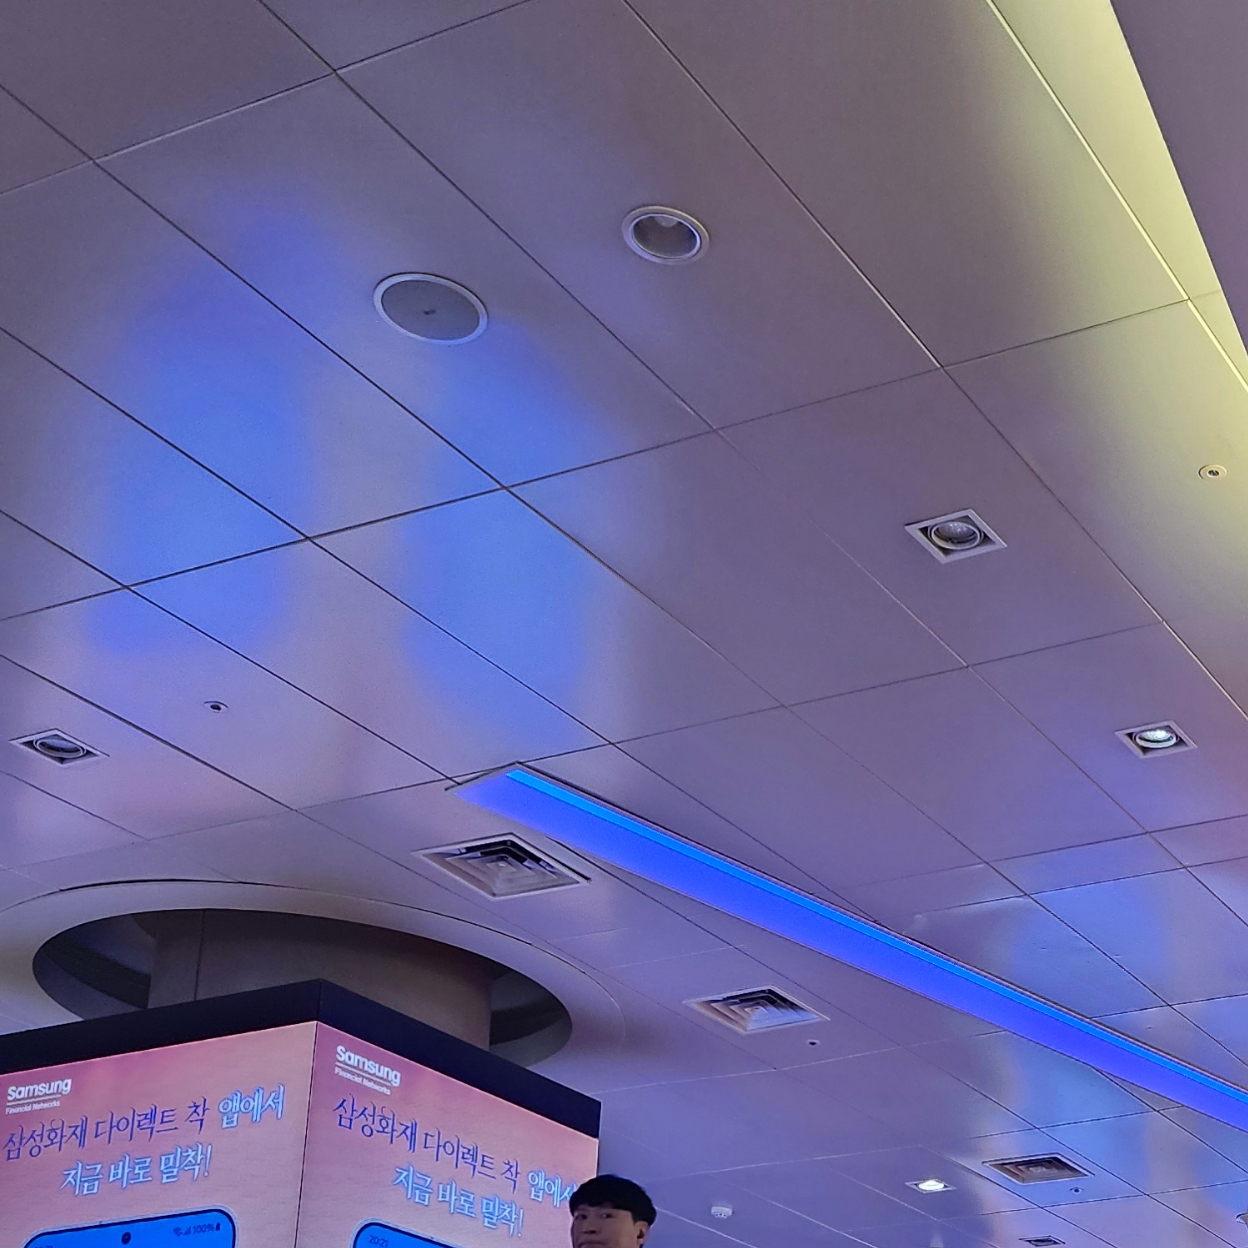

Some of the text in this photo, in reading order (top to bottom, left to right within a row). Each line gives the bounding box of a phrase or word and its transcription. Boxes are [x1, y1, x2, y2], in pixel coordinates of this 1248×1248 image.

[7, 1079, 72, 1100] Samsung
[336, 1046, 401, 1087] Samsung
[4, 1083, 286, 1161] 삼성화재 다이렉트 착 앱에서
[333, 1093, 418, 1153] 삼성화재
[423, 1128, 497, 1180] 다이렉트
[501, 1158, 521, 1194] 착
[60, 1143, 213, 1196] 지금 바로 밀착!
[393, 1163, 524, 1238] 지금 바로 밀착!
[192, 1223, 215, 1234] 100%
